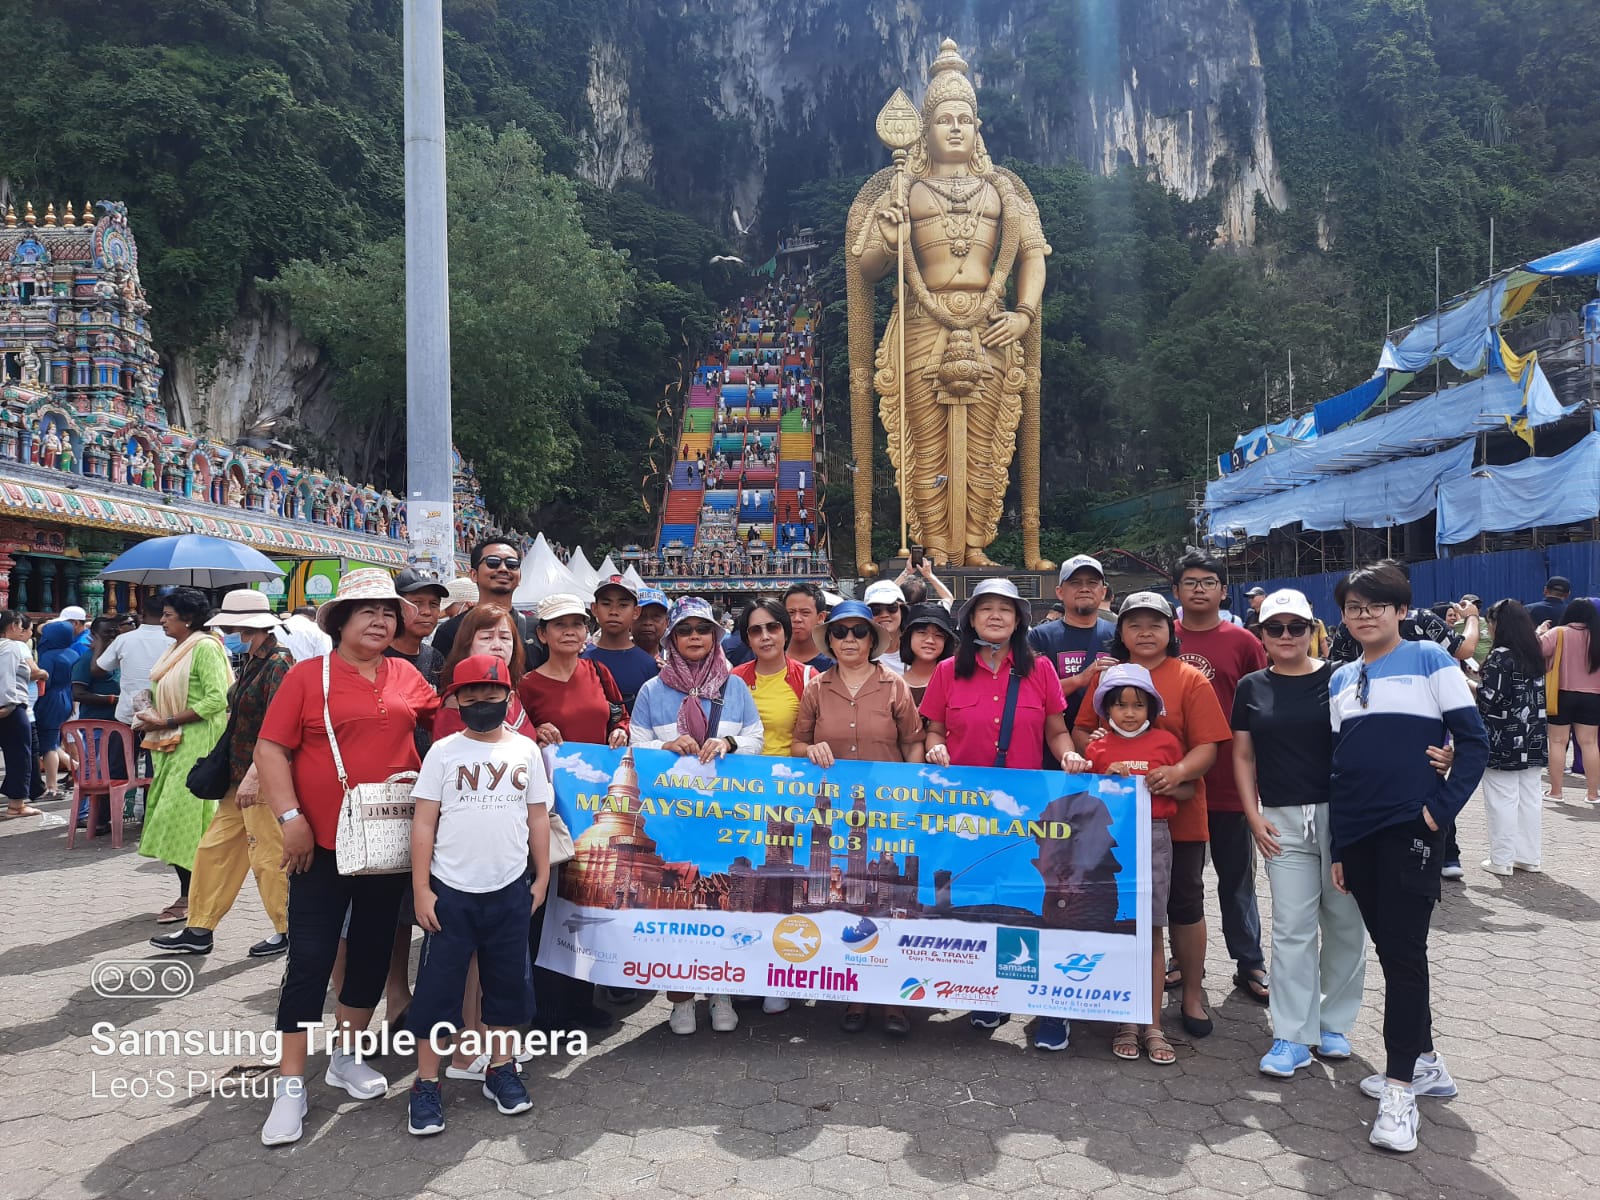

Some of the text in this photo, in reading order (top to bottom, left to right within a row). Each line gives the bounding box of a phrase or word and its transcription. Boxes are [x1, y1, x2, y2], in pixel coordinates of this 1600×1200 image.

[456, 760, 528, 791] NYC
[460, 794, 504, 803] ATHLETIC
[654, 773, 994, 806] AMAZING TOUR 3 COUNTRY
[828, 835, 862, 850] 03
[871, 837, 916, 854] Juli
[633, 921, 725, 937] ASTRINDO
[898, 934, 988, 953] NIRWANA
[869, 955, 888, 965] Tour
[901, 949, 928, 957] TOUR
[942, 951, 980, 960] TRAVEL
[622, 958, 746, 985] ayowisata
[767, 962, 859, 991] interlink
[998, 963, 1037, 974] samasta
[934, 980, 999, 999] Harvest
[1027, 983, 1131, 1002] J3 HOLIDAYS
[1051, 998, 1068, 1006] Tour
